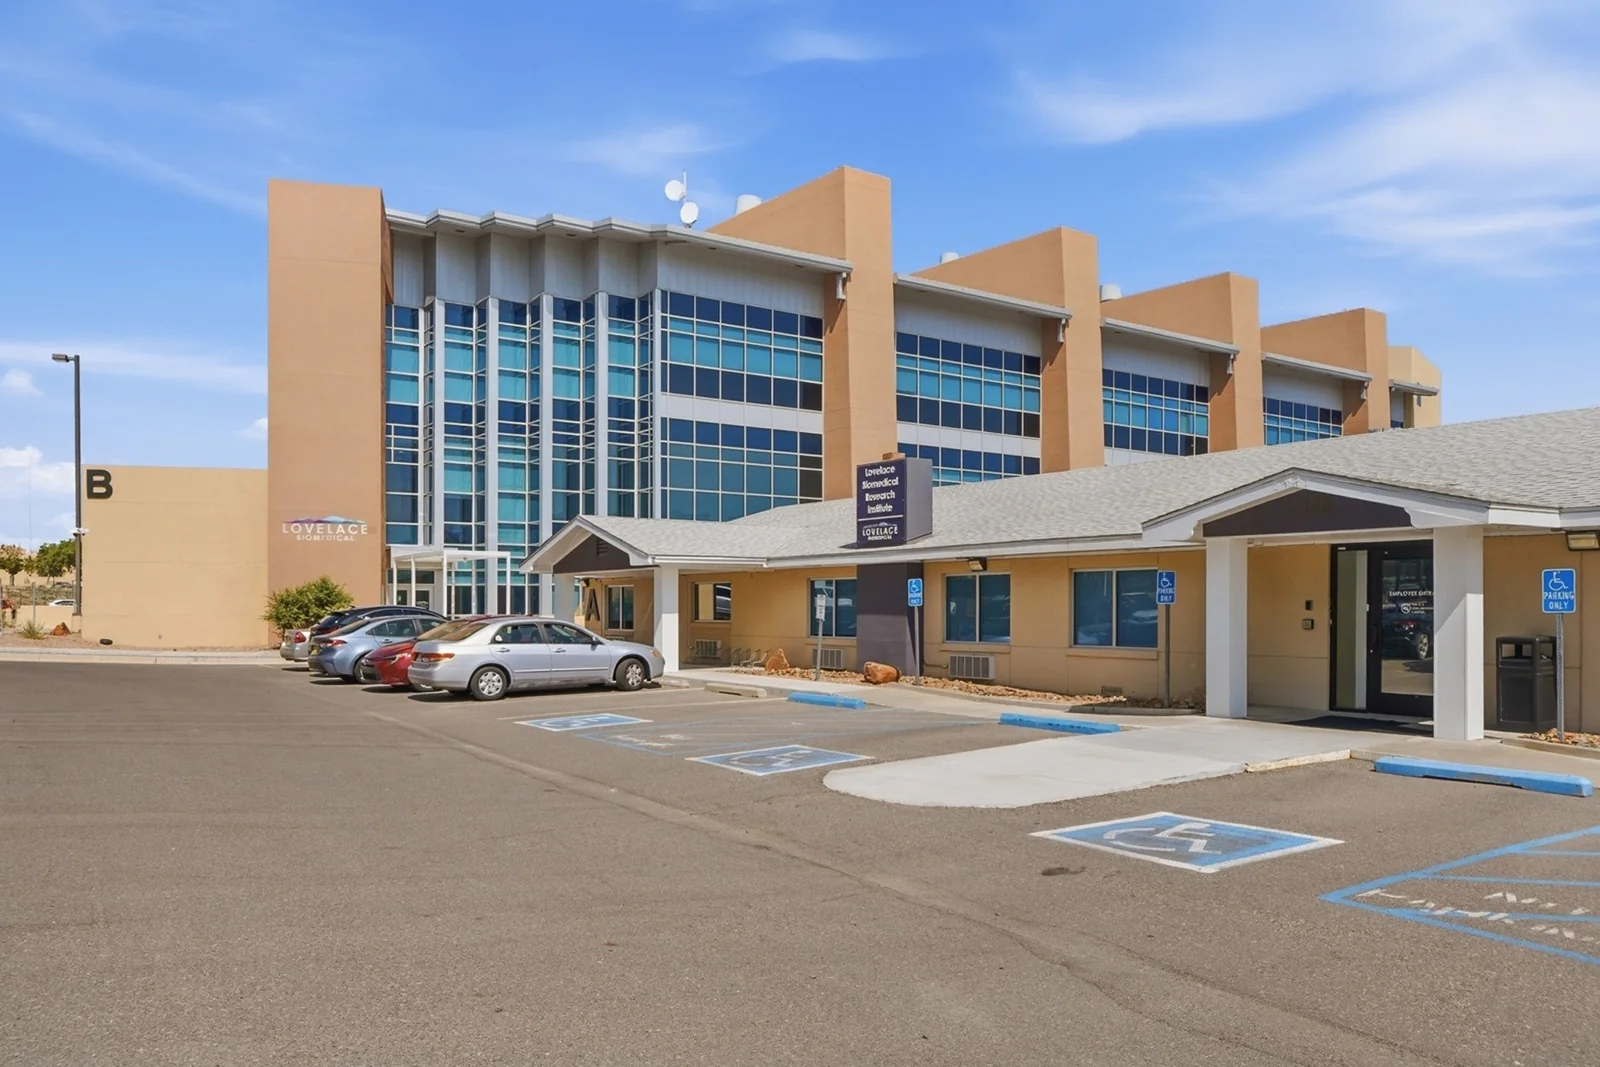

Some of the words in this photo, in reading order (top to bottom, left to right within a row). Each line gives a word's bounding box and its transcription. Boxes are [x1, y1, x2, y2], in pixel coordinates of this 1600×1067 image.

[864, 465, 896, 477] Lovelace
[86, 469, 113, 499] B
[862, 476, 899, 490] Biomedical
[865, 490, 896, 501] Research
[867, 503, 893, 514] Institute
[282, 523, 368, 535] LOVELACE
[862, 526, 898, 537] LOVELACE
[296, 534, 355, 542] BIOMEDICAL
[1543, 591, 1575, 600] PARKING
[585, 588, 600, 621] A
[1548, 601, 1569, 610] ONLY
